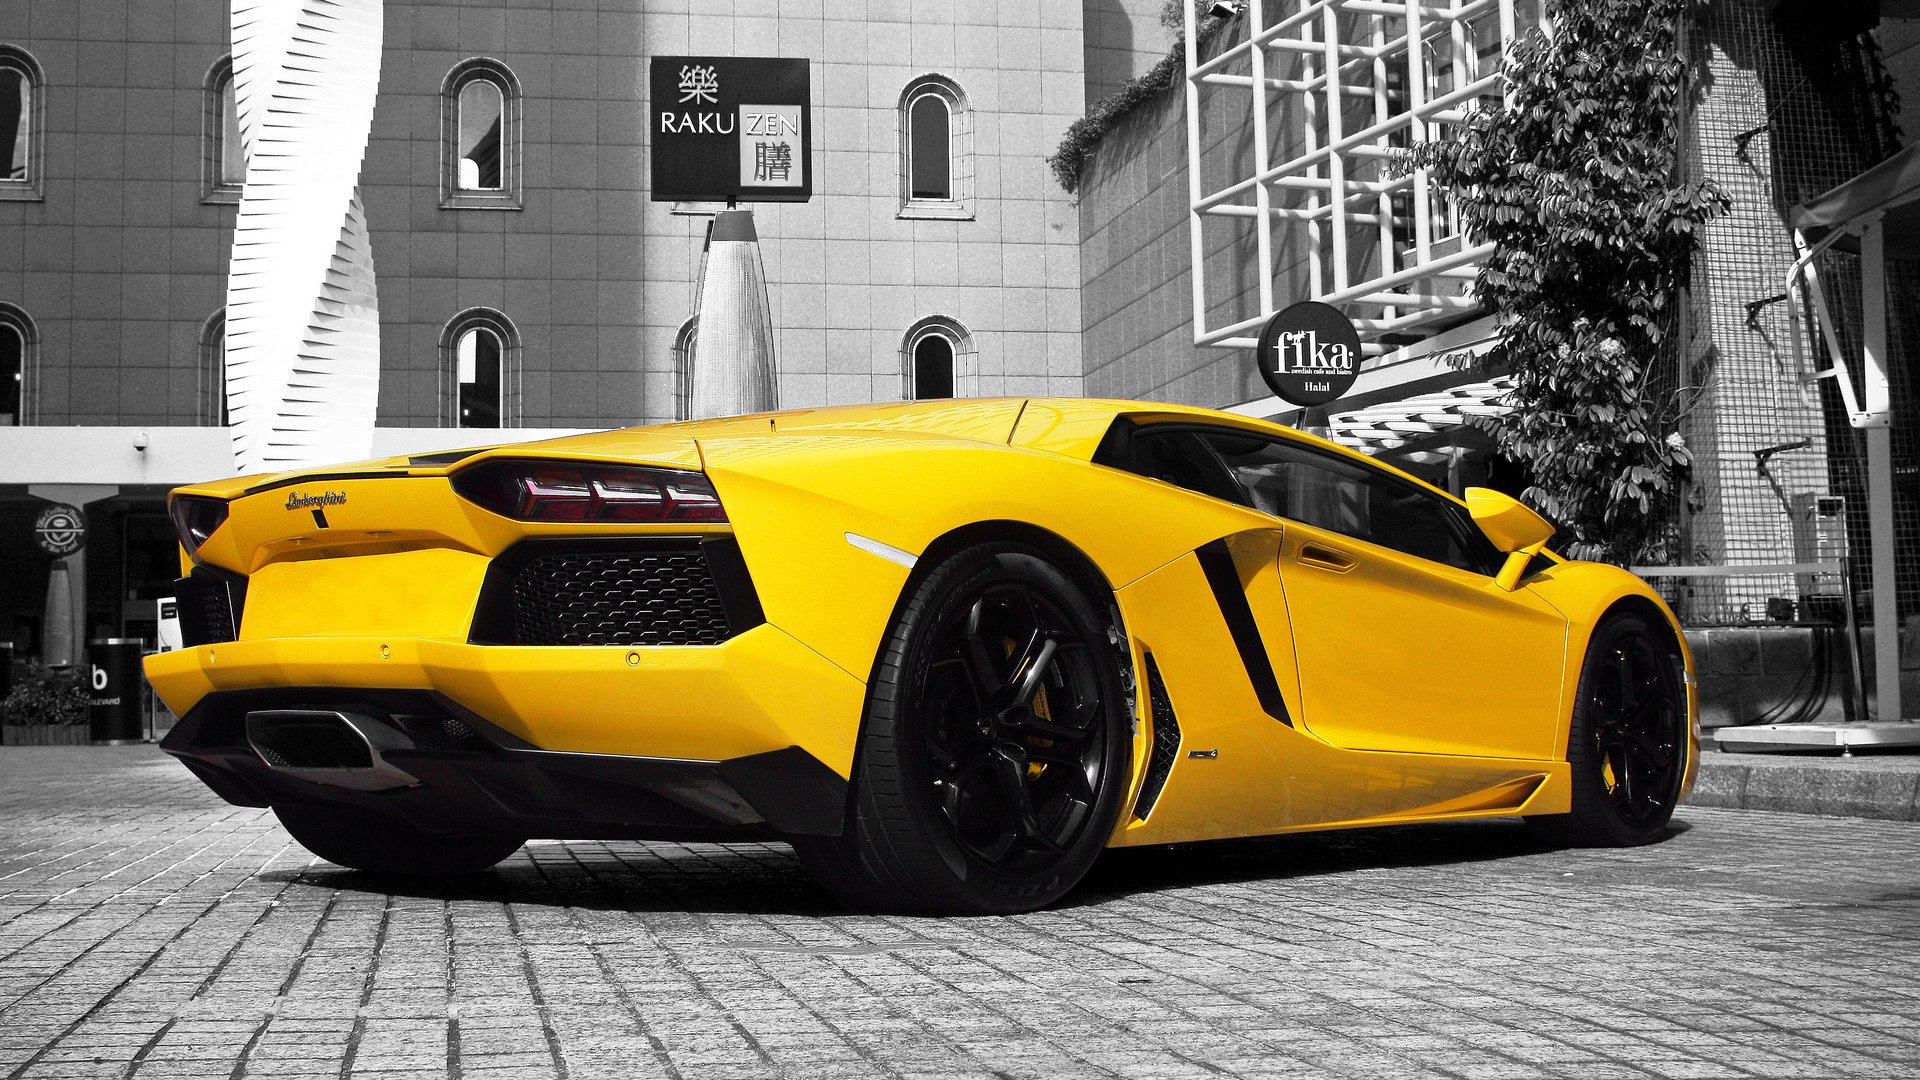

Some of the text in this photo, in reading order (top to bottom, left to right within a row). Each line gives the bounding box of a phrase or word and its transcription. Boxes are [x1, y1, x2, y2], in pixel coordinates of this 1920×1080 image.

[678, 64, 718, 105] 樂
[661, 112, 798, 136] RAKU ZEN
[753, 141, 792, 181] 膳
[1304, 381, 1330, 392] Halal
[91, 663, 108, 690] b
